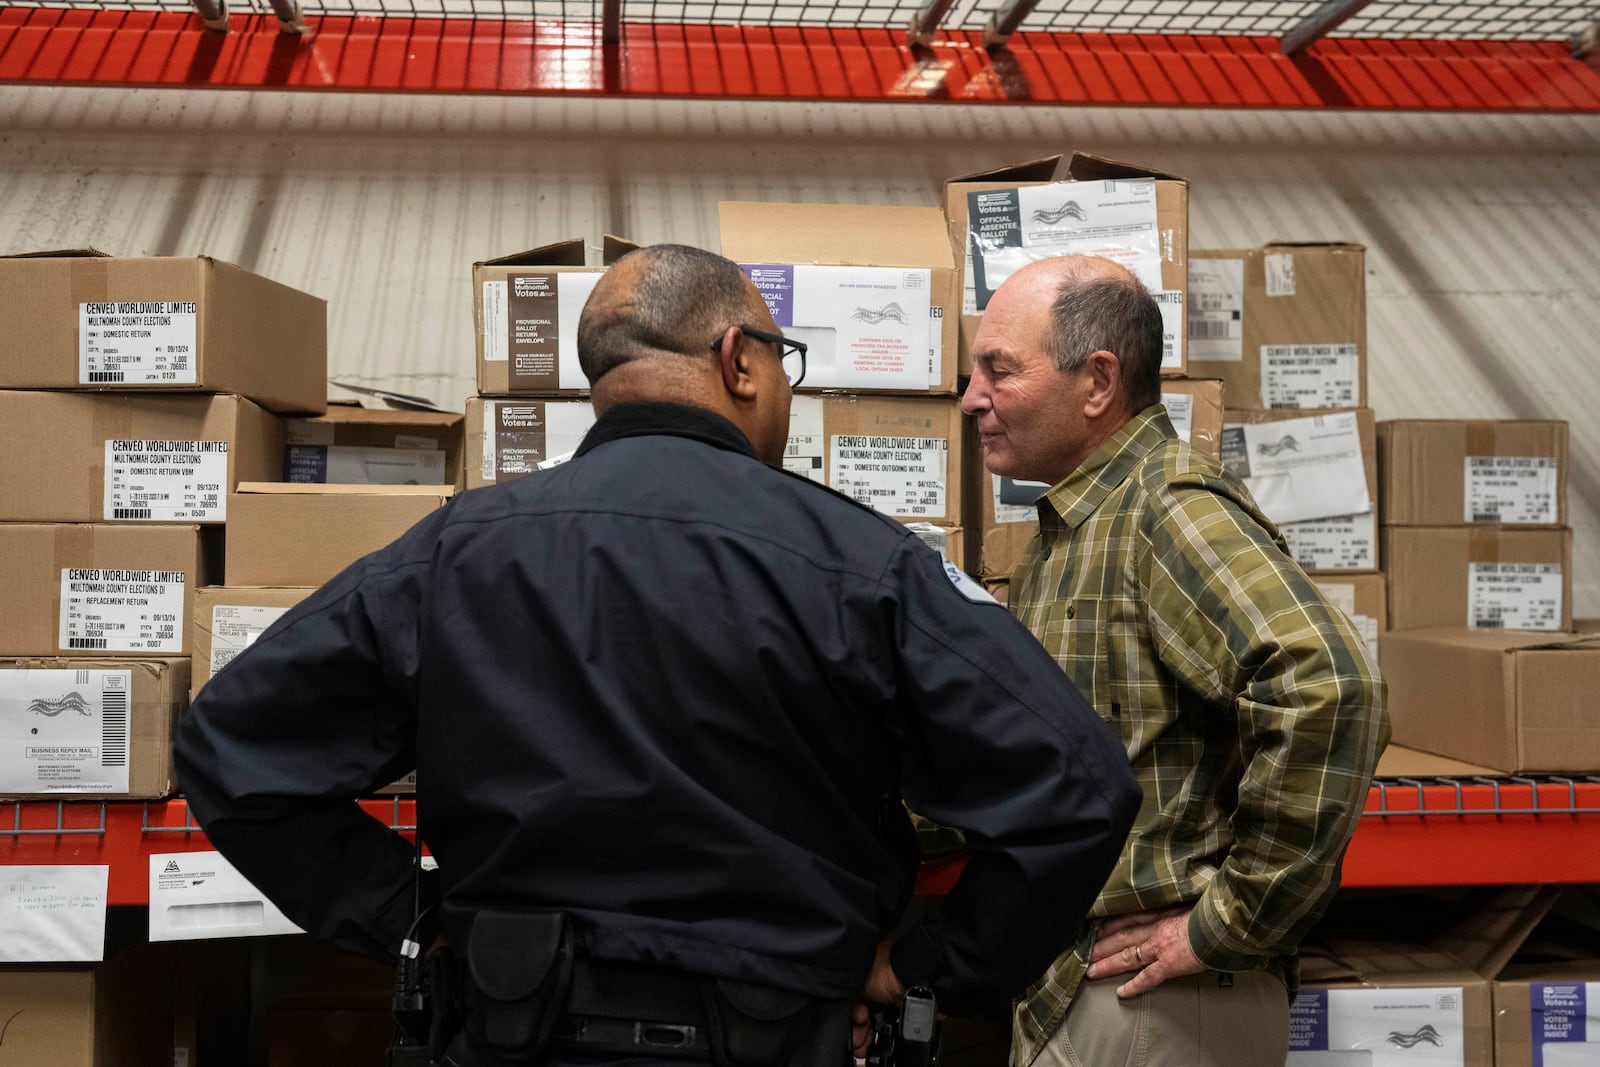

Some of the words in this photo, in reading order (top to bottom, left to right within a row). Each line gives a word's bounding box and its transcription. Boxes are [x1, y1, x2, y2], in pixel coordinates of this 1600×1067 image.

[980, 216, 1011, 224] OFFICIAL
[980, 222, 1017, 231] ABSENTEE
[981, 230, 1008, 238] BALLOT
[87, 303, 115, 314] CENVEO
[118, 303, 164, 314] WORLDWIDE
[167, 303, 196, 314] LIMITED
[88, 316, 120, 326] MULTNOMAH
[122, 316, 142, 326] COUNTY
[144, 316, 171, 326] ELECTIONS
[113, 441, 142, 452] CENVEO
[146, 441, 194, 452] WORLDWIDE
[197, 442, 228, 452] LIMITED
[838, 436, 867, 447] CENVEO
[870, 438, 916, 449] WORLDWIDE
[919, 439, 948, 450] LIMITD
[114, 454, 148, 463] MULTNOMAH
[150, 455, 171, 464] COUNTY
[173, 455, 201, 464] ELECTIONS
[840, 450, 872, 459] MULTNOMAH
[873, 450, 893, 460] COUNTY
[895, 451, 922, 461] ELECTIONS
[70, 569, 99, 580] CENVEO
[102, 570, 151, 582] WORLDWIDE
[154, 571, 185, 583] LIMITED
[71, 583, 105, 592] MULTONMAH
[107, 584, 128, 593] COUNTY
[130, 585, 158, 594] ELECTIONS
[160, 586, 165, 594] DI
[86, 597, 125, 605] REPLACEMENT
